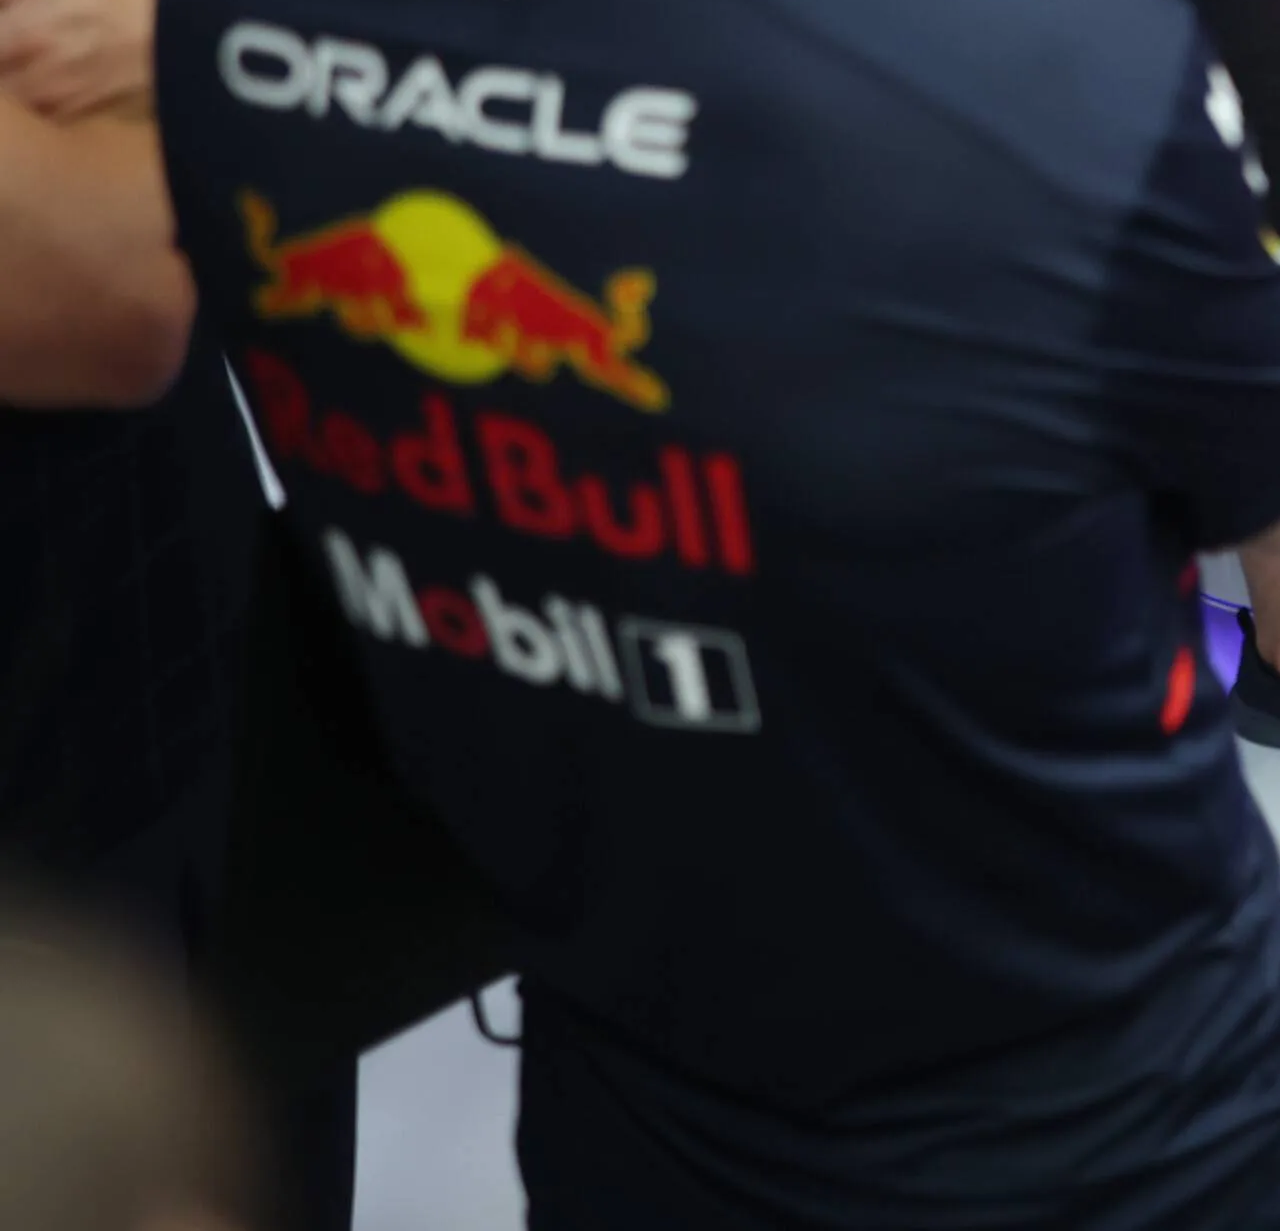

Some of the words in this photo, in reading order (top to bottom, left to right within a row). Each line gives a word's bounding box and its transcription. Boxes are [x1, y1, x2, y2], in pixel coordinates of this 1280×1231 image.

[217, 19, 699, 180] ORACLE
[246, 348, 474, 517] Red
[475, 410, 753, 574] Bull
[323, 527, 624, 706] Mobil
